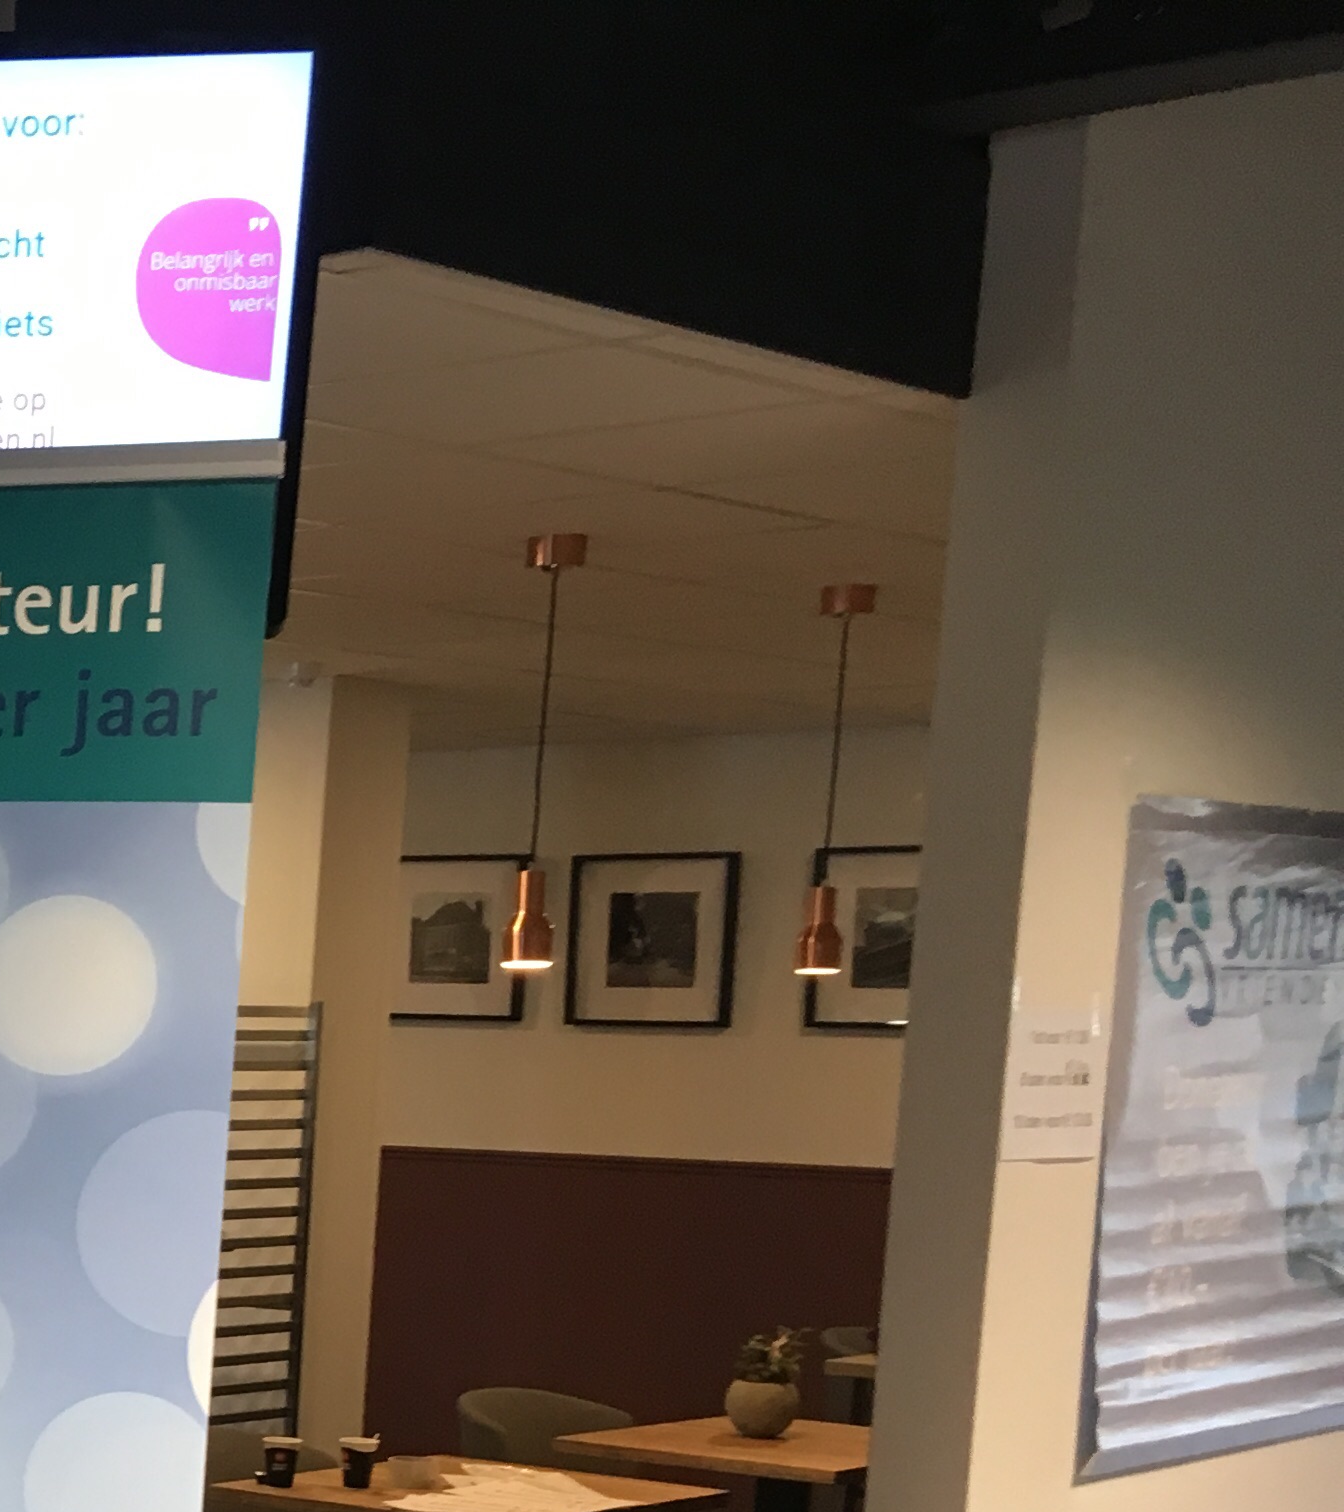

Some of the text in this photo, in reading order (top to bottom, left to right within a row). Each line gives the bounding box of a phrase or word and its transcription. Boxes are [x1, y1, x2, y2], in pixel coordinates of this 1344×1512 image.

[2, 112, 86, 138] voor:
[150, 249, 275, 275] Belangrijk en
[173, 273, 279, 292] onmisbaar
[228, 295, 278, 312] werk
[13, 390, 46, 416] op
[59, 668, 219, 757] jaar
